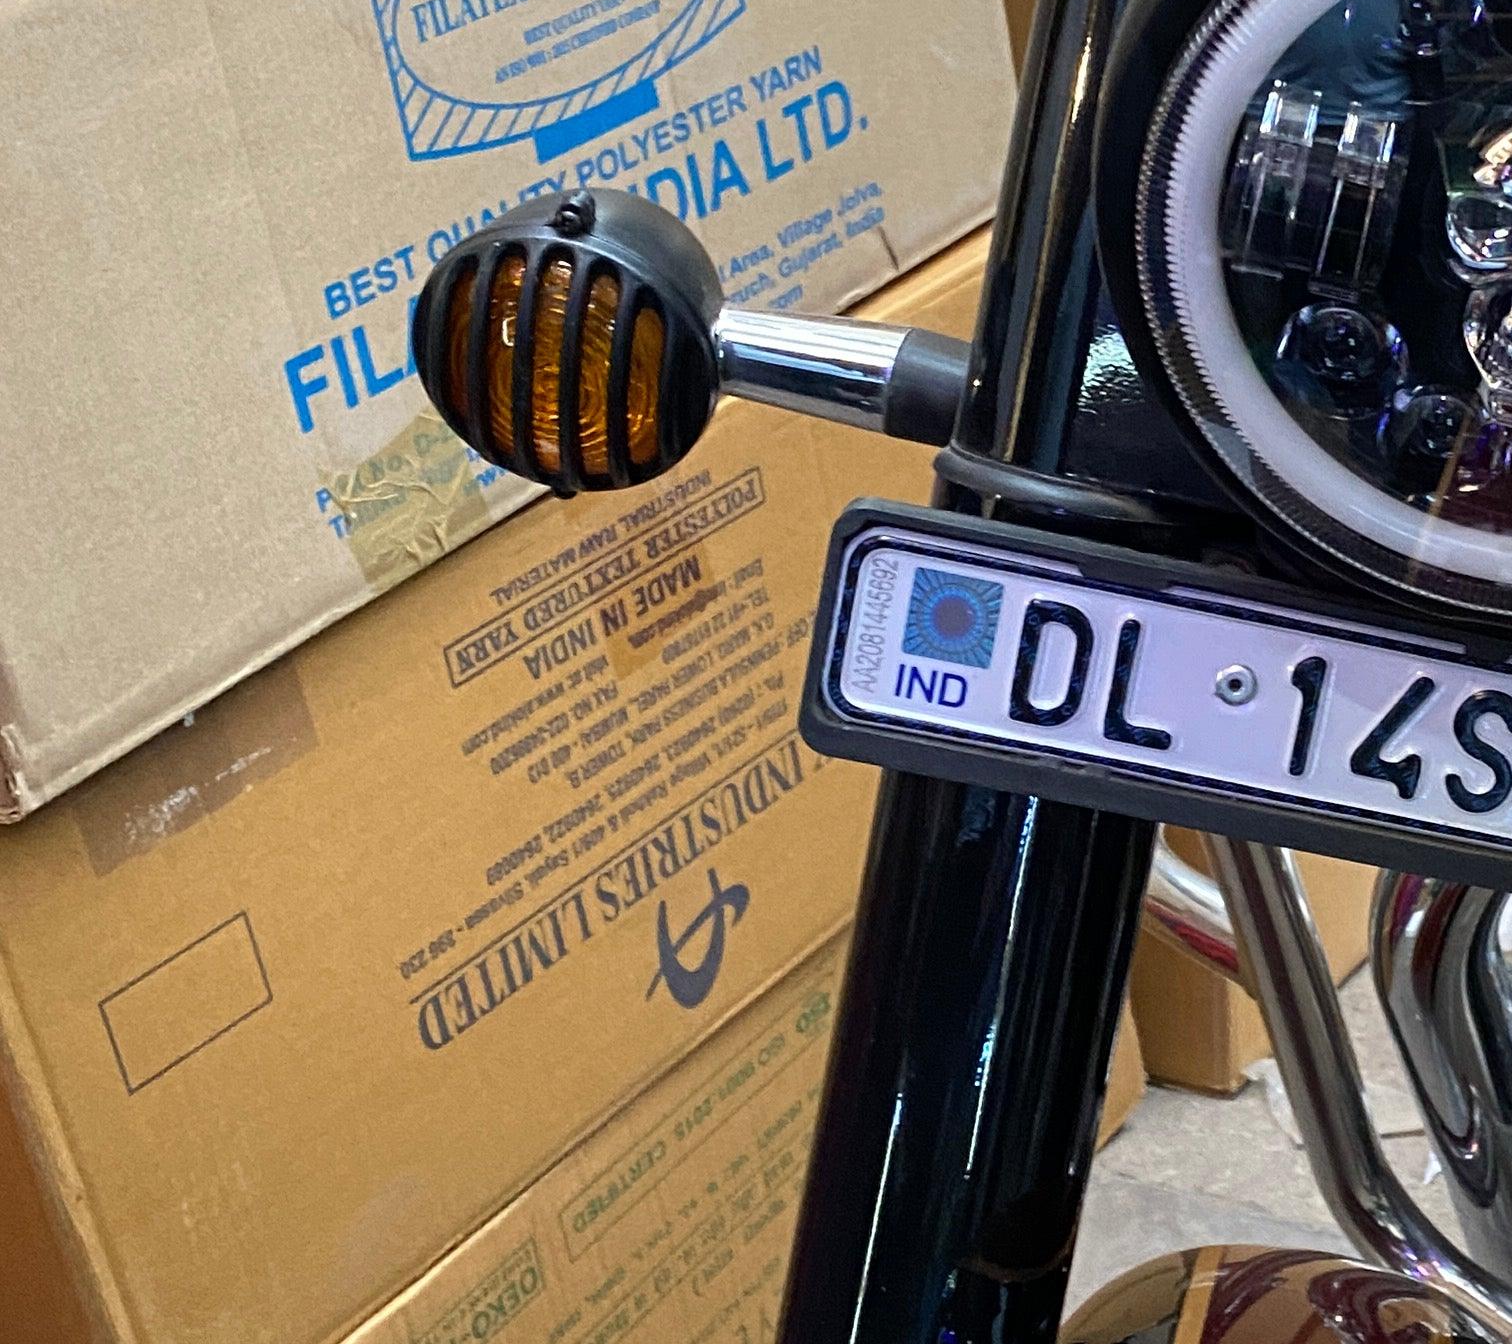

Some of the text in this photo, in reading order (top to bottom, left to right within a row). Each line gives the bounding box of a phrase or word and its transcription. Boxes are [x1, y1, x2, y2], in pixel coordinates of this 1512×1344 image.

[756, 79, 868, 183] LTD.
[323, 244, 417, 320] BEST
[576, 83, 748, 190] POLYESTER
[749, 44, 824, 103] YARN
[617, 470, 711, 531] INDUSTRIAL
[643, 479, 763, 559] POLYESTER
[523, 548, 640, 630] TEXTURED
[599, 598, 628, 637] IN
[632, 555, 701, 616] MADE
[851, 557, 899, 694] AA2081445692
[455, 621, 518, 674] YARN
[522, 618, 596, 679] INDIA
[895, 664, 968, 708] IND
[1009, 598, 1172, 751] DL
[418, 734, 803, 1050] INDUSTRIES LIMITED
